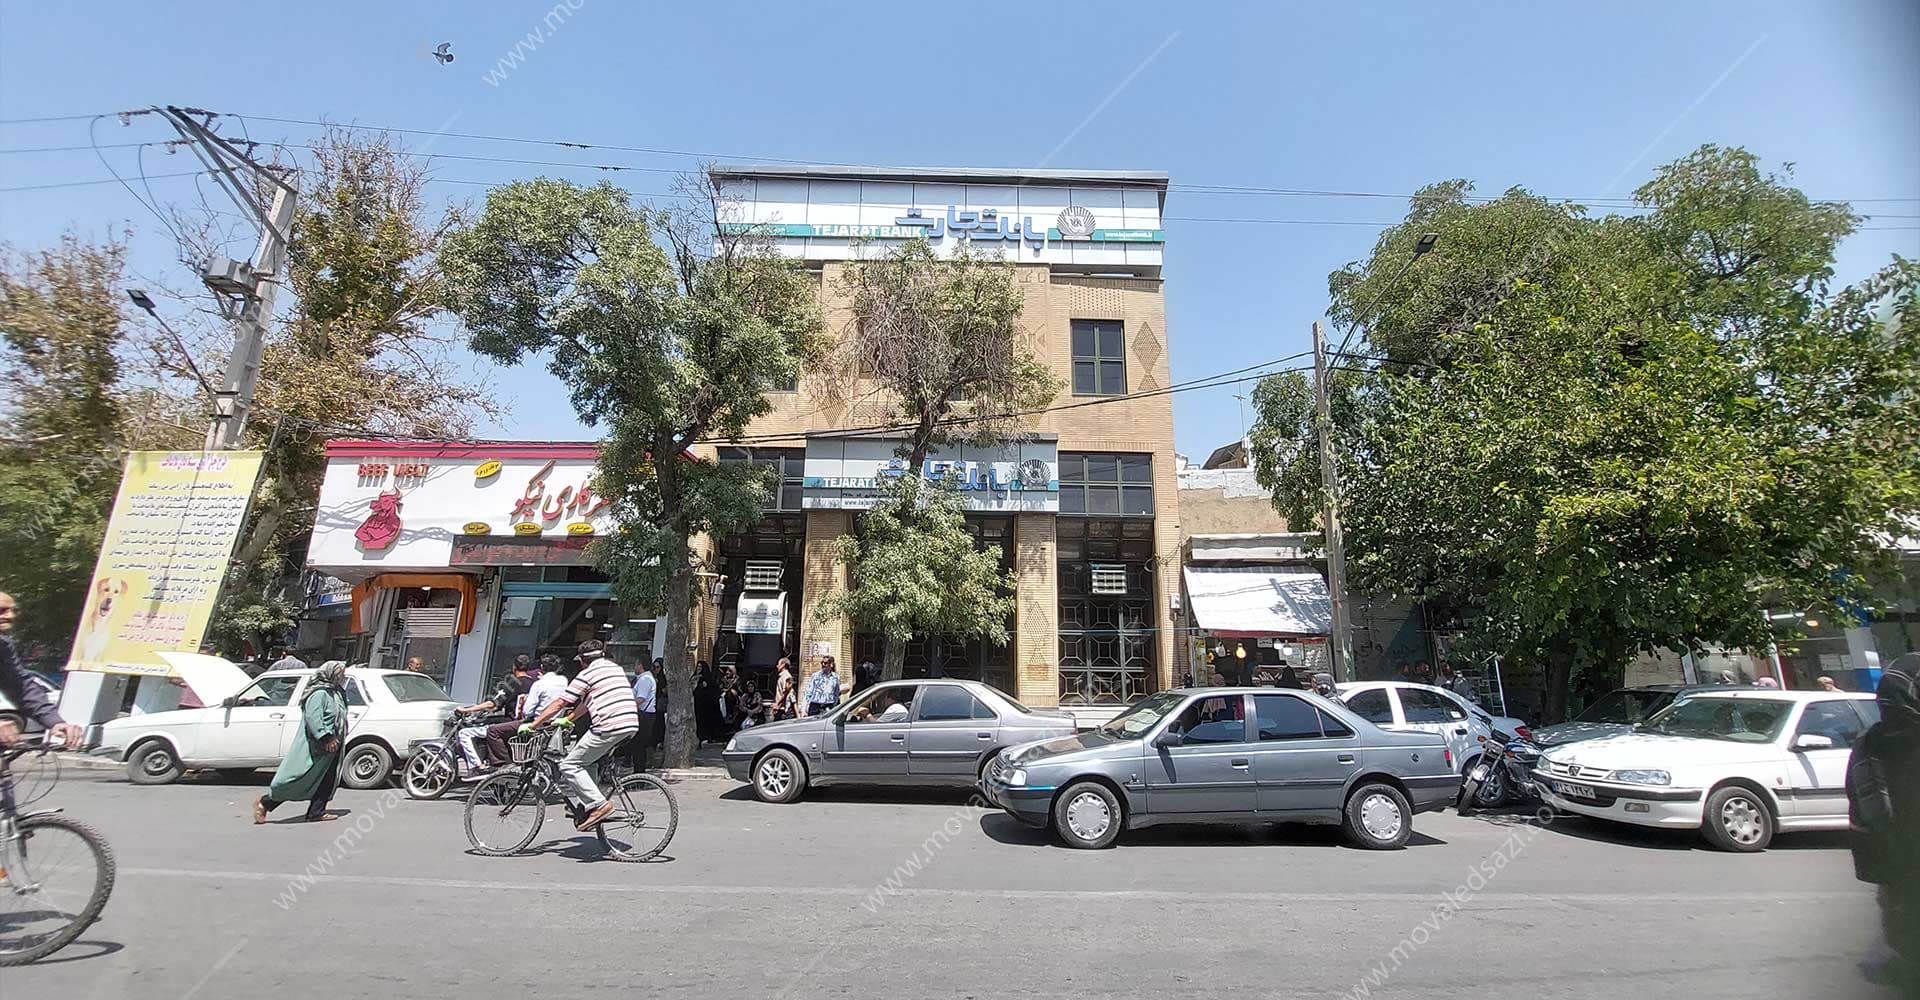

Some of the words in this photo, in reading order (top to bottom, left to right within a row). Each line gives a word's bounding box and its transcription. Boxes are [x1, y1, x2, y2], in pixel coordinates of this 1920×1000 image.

[895, 205, 997, 238] تجارت
[813, 224, 878, 238] TEJARAT
[882, 225, 923, 239] BANK
[970, 215, 1045, 250] بانک
[358, 463, 389, 476] BEEF
[823, 477, 872, 488] TEJARAT
